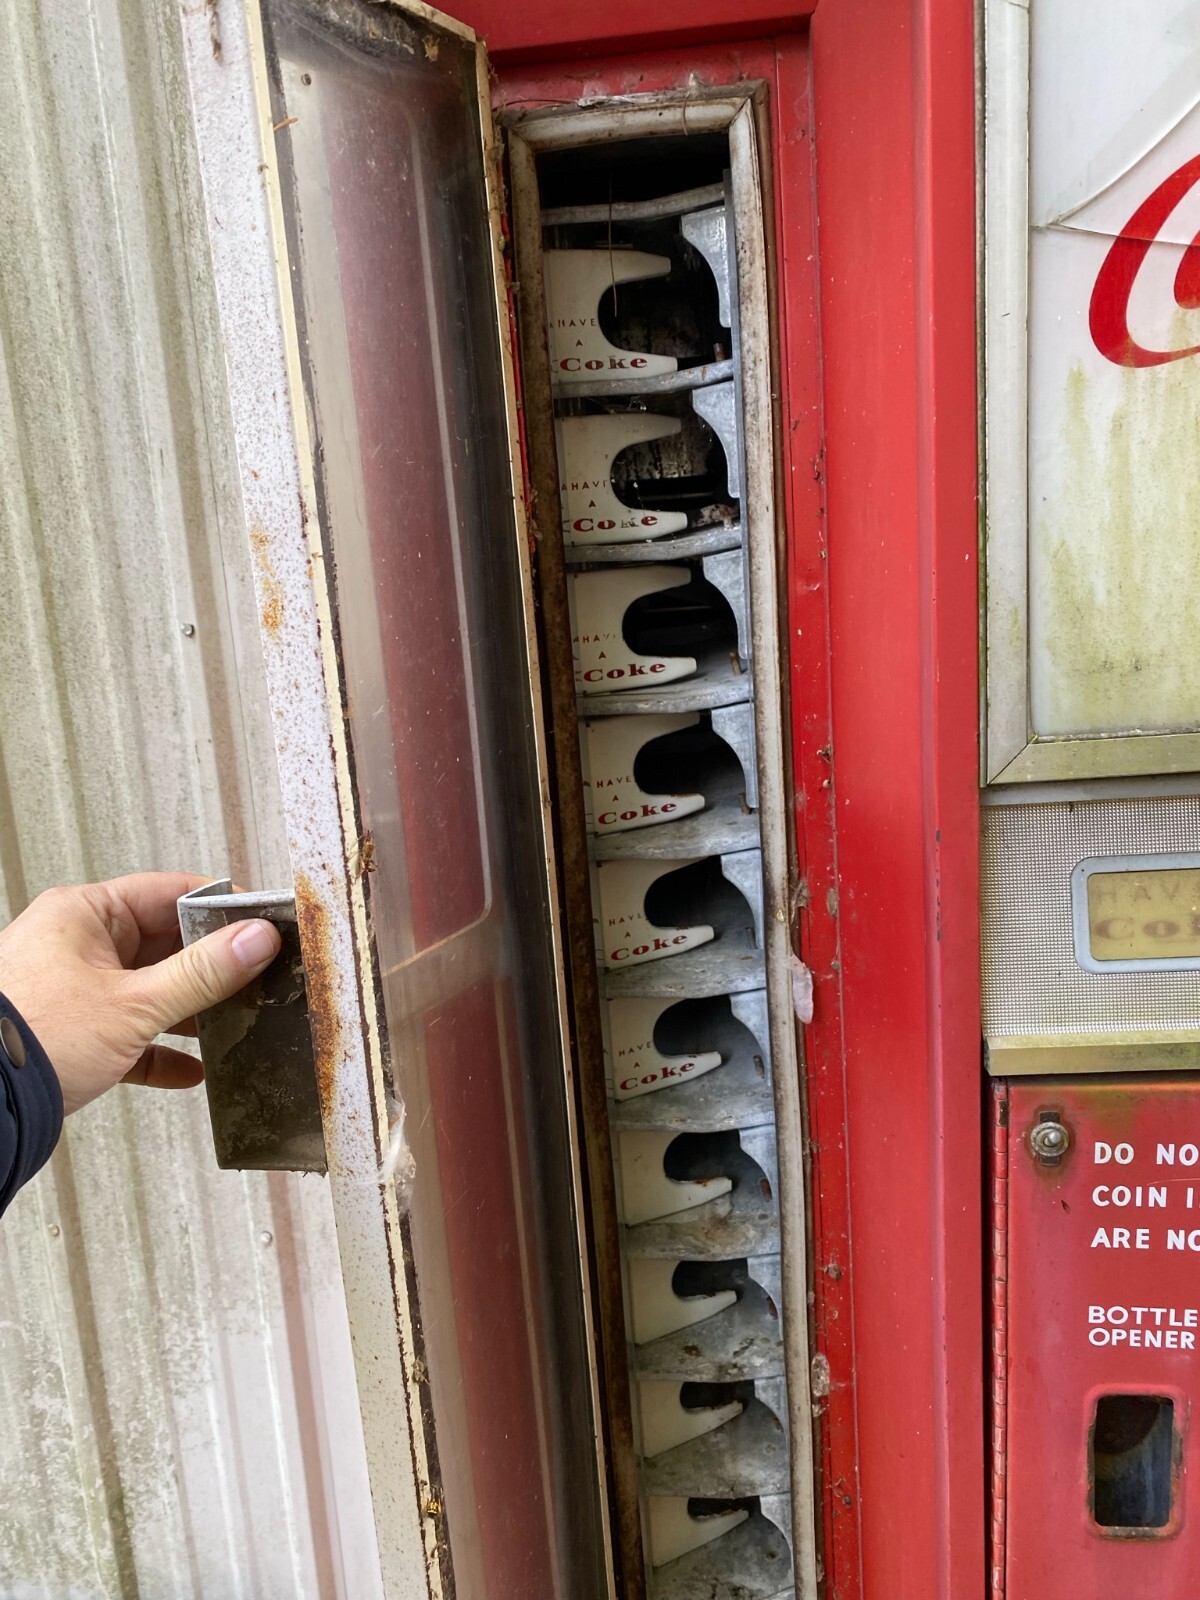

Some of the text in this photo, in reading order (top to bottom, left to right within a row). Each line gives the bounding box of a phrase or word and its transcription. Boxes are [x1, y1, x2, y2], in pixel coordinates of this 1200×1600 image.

[575, 339, 583, 347] A
[560, 356, 648, 372] Coke
[588, 500, 596, 508] A
[598, 651, 606, 659] A
[583, 662, 666, 682] Coke
[596, 775, 632, 788] HAVE
[598, 802, 677, 825] Coke
[611, 935, 688, 960] Coke
[618, 1041, 652, 1057] HAVE
[619, 1061, 695, 1090] Coke
[1094, 1142, 1135, 1165] DO
[1092, 1185, 1167, 1208] COIN
[1090, 1227, 1150, 1249] ARE
[1088, 1305, 1198, 1327] BOTTLE
[1088, 1328, 1195, 1350] OPENER
